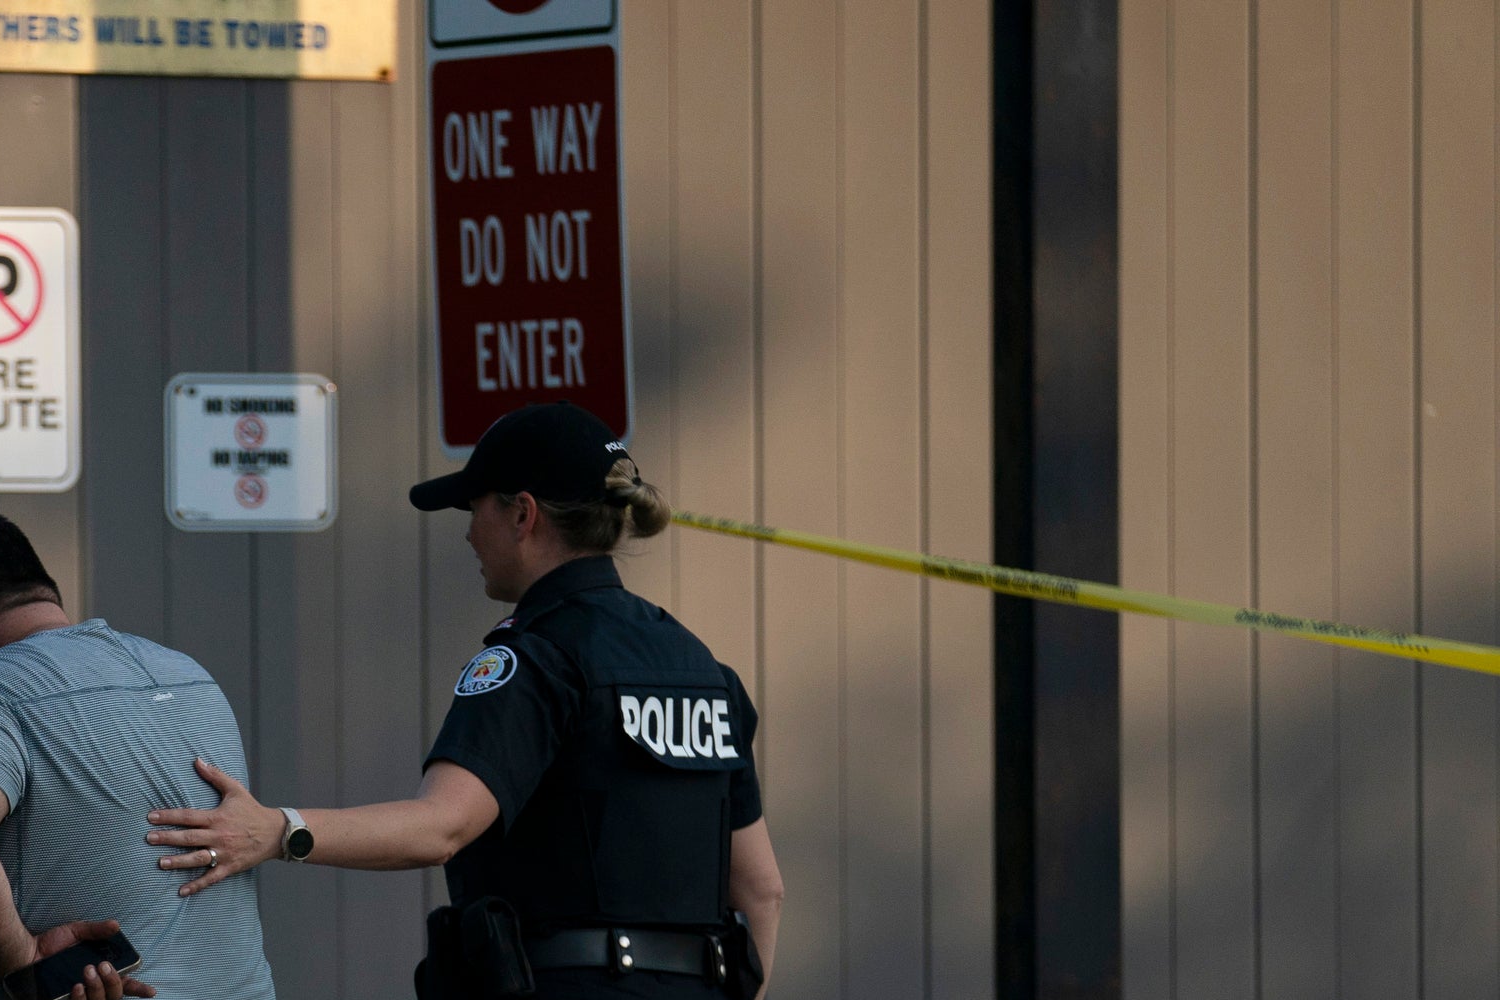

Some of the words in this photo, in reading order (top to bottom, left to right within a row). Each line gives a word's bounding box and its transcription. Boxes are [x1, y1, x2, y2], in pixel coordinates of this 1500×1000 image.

[94, 17, 163, 47] WILL
[174, 18, 212, 48] BE
[223, 21, 329, 50] TOWED
[443, 109, 514, 183] ONE
[530, 101, 602, 176] WAY
[460, 214, 506, 287] DO
[525, 209, 591, 283] NOT
[475, 317, 586, 391] ENTER
[620, 695, 739, 759] POLICE
